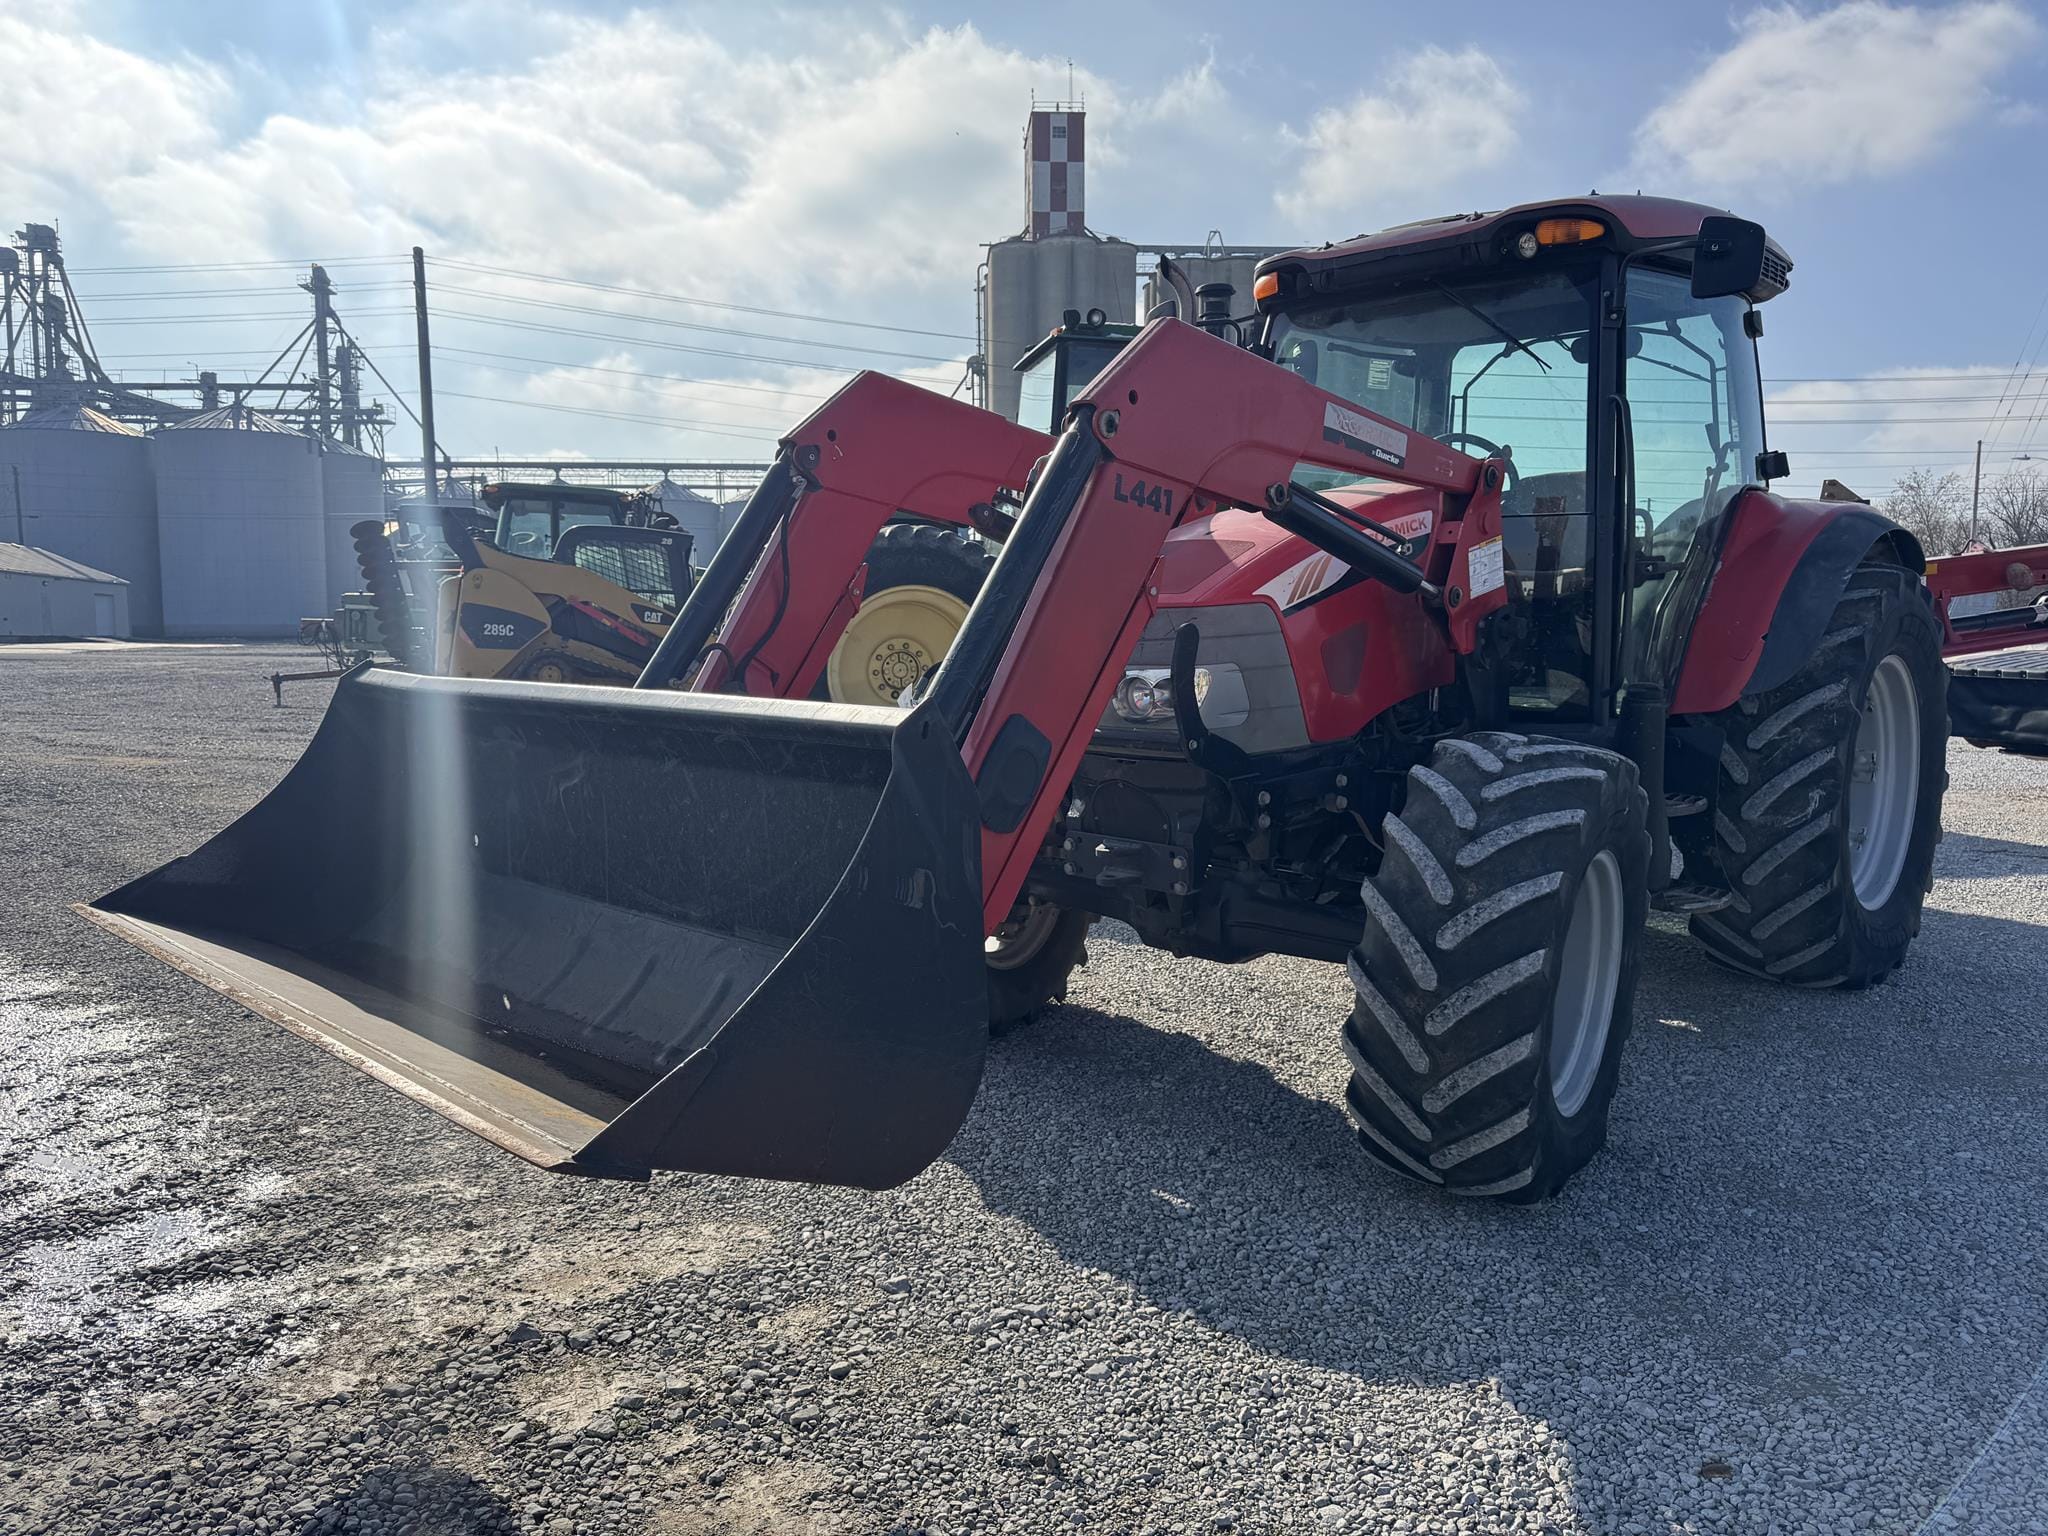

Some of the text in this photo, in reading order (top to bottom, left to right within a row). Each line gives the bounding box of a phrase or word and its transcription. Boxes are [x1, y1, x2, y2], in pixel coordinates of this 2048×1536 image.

[1375, 448, 1400, 465] Quicke
[1114, 473, 1173, 516] L441
[643, 611, 664, 624] CAT
[483, 623, 515, 636] 289C
